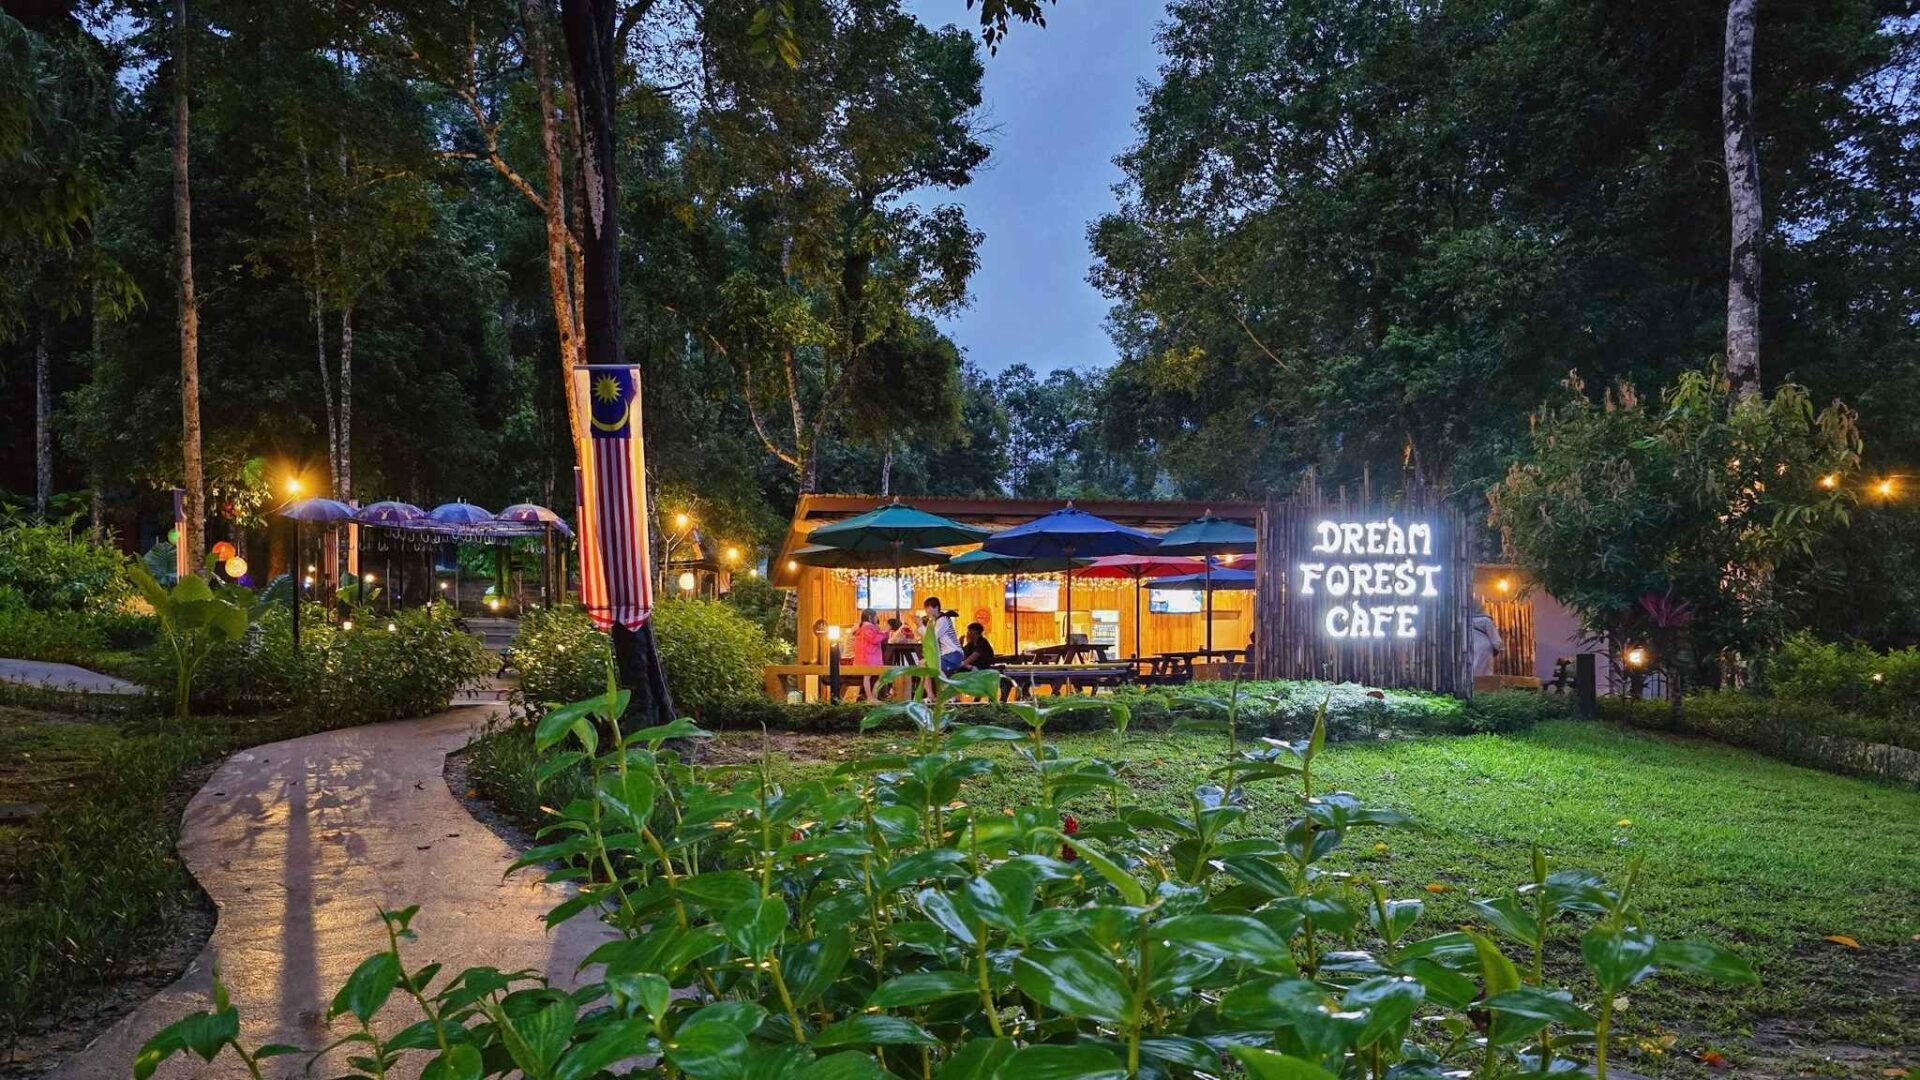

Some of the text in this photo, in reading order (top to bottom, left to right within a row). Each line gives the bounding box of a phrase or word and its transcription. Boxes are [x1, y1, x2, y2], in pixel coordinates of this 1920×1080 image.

[1312, 517, 1432, 555] DREAM
[1299, 559, 1442, 596] FOREST
[1325, 600, 1419, 638] CAFE
